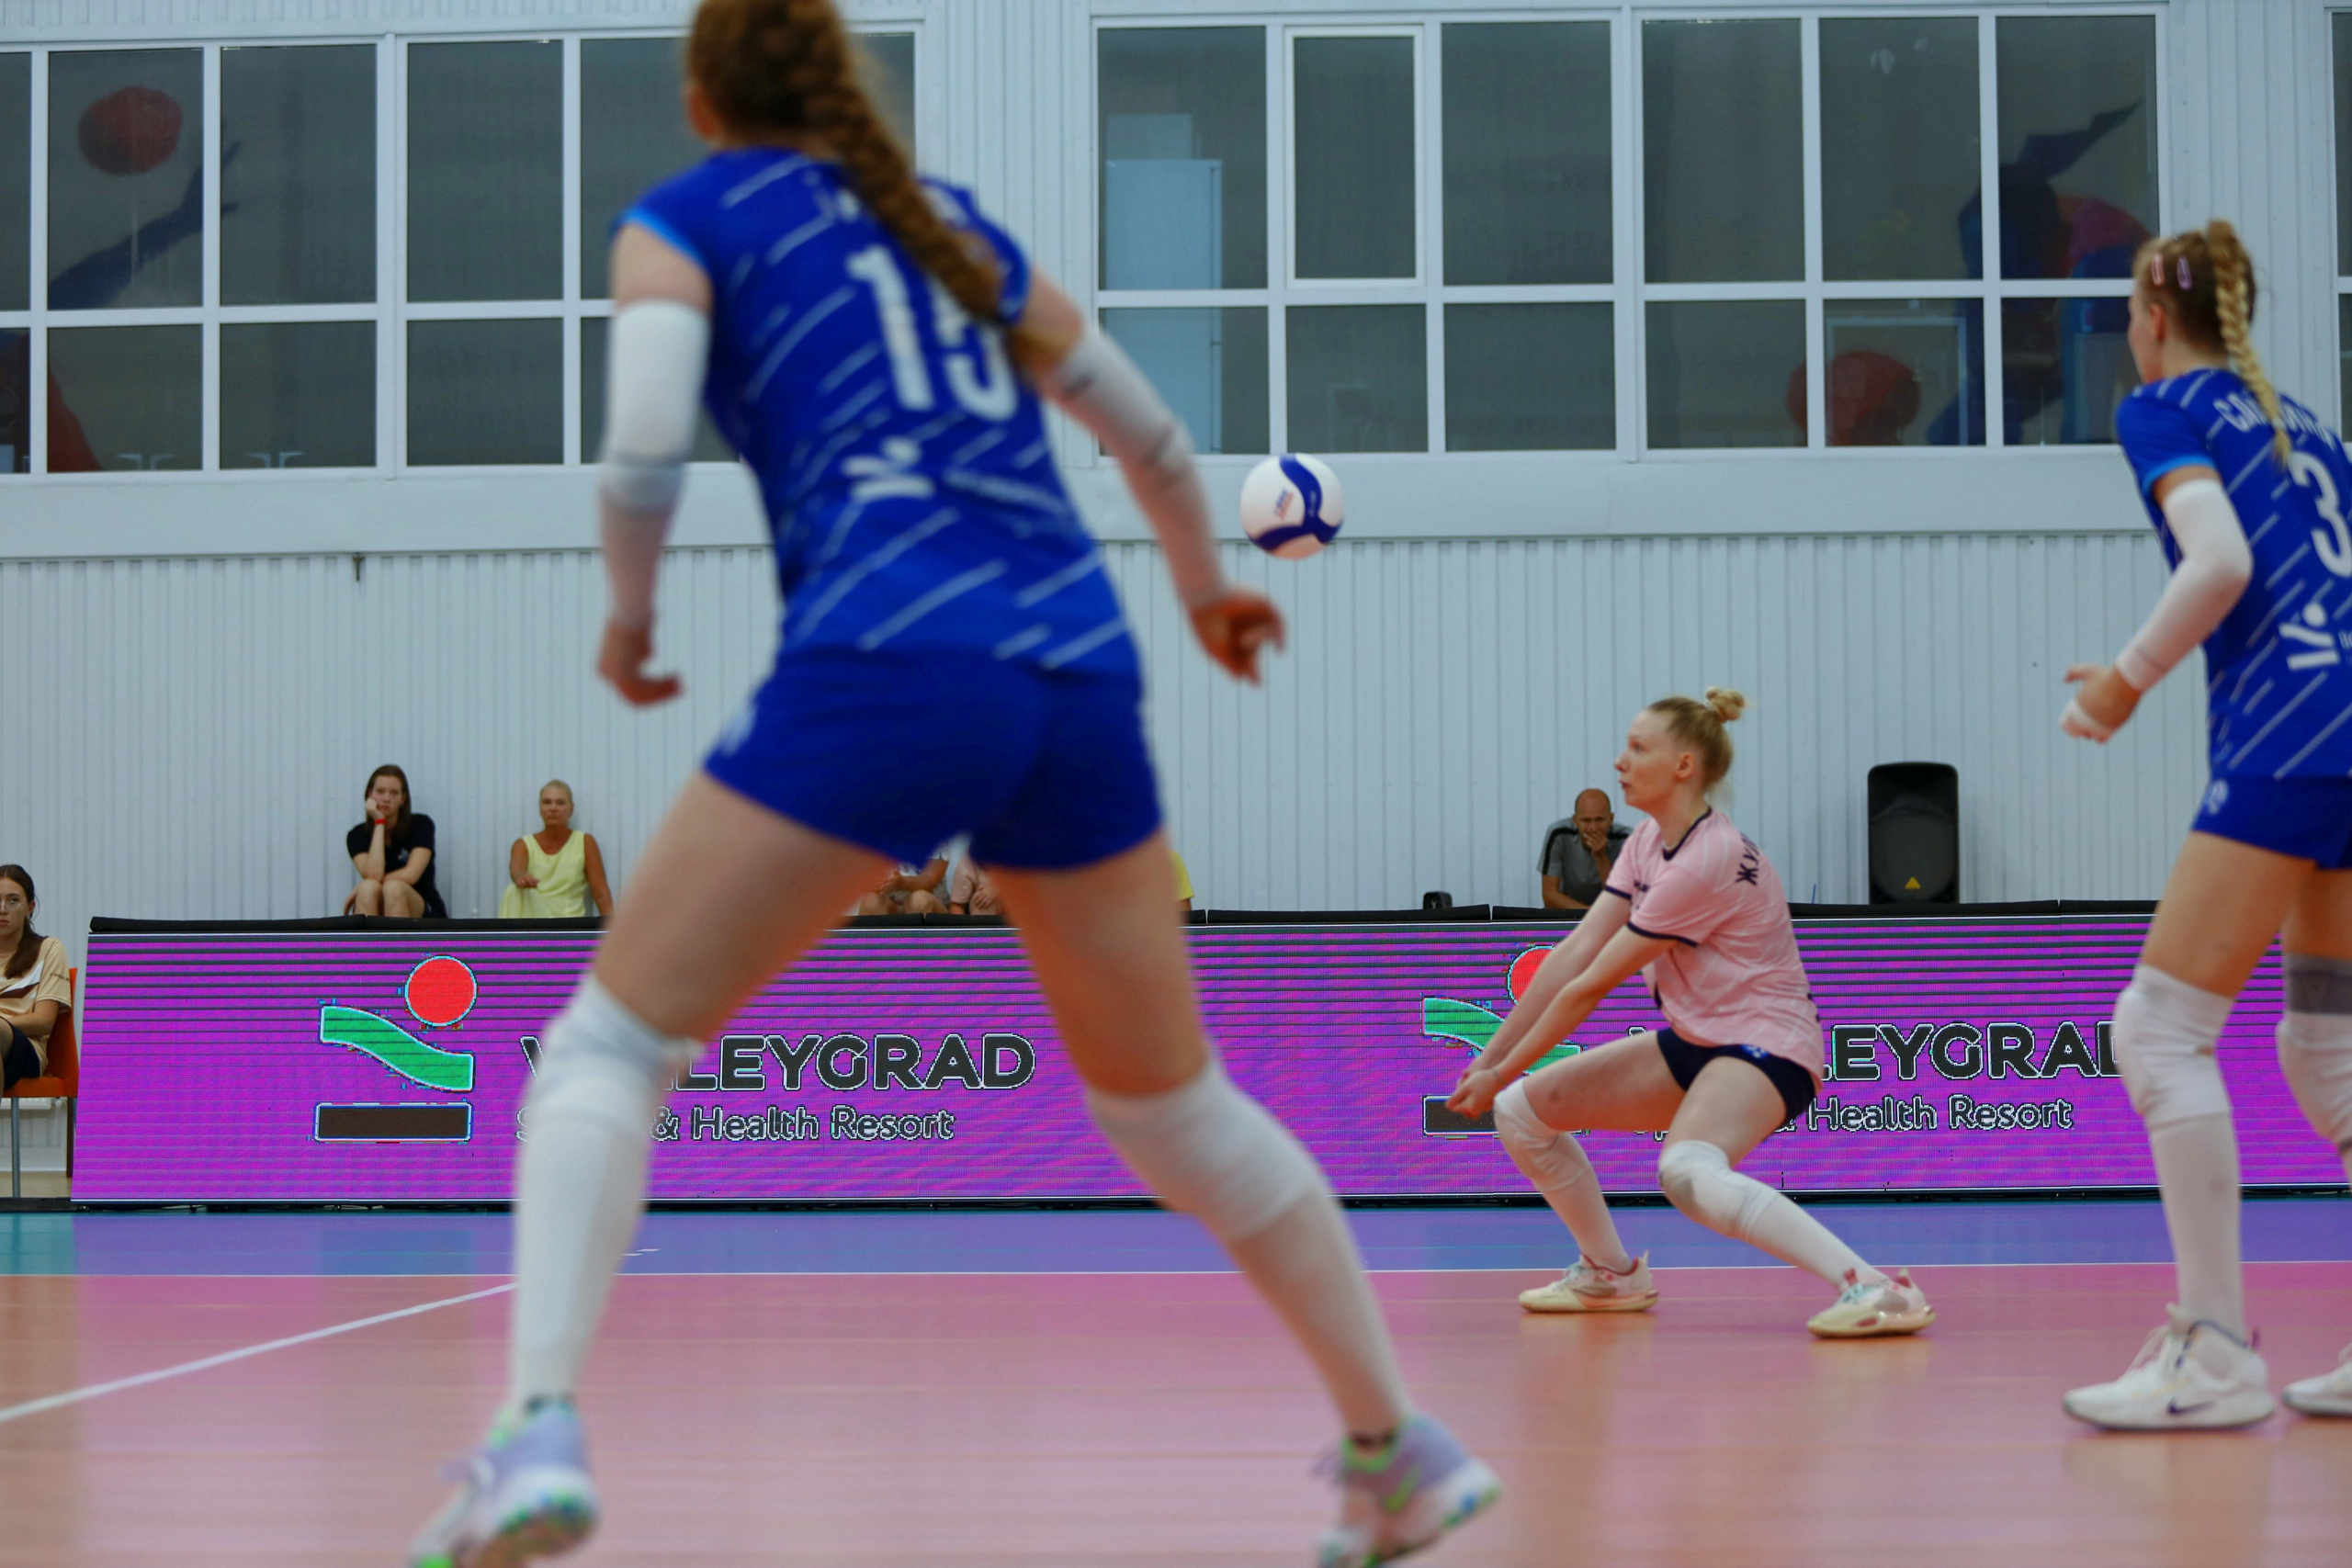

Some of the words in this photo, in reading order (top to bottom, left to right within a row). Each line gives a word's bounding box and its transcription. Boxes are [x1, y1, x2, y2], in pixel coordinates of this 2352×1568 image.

[846, 243, 1019, 422] 15
[2289, 451, 2352, 578] 3
[519, 1033, 1035, 1090] LEYGRAD
[649, 1105, 681, 1141] &
[692, 1105, 820, 1141] Health
[831, 1105, 956, 1140] Resort
[1806, 1095, 1938, 1132] Health
[1948, 1094, 2074, 1131] Resort
